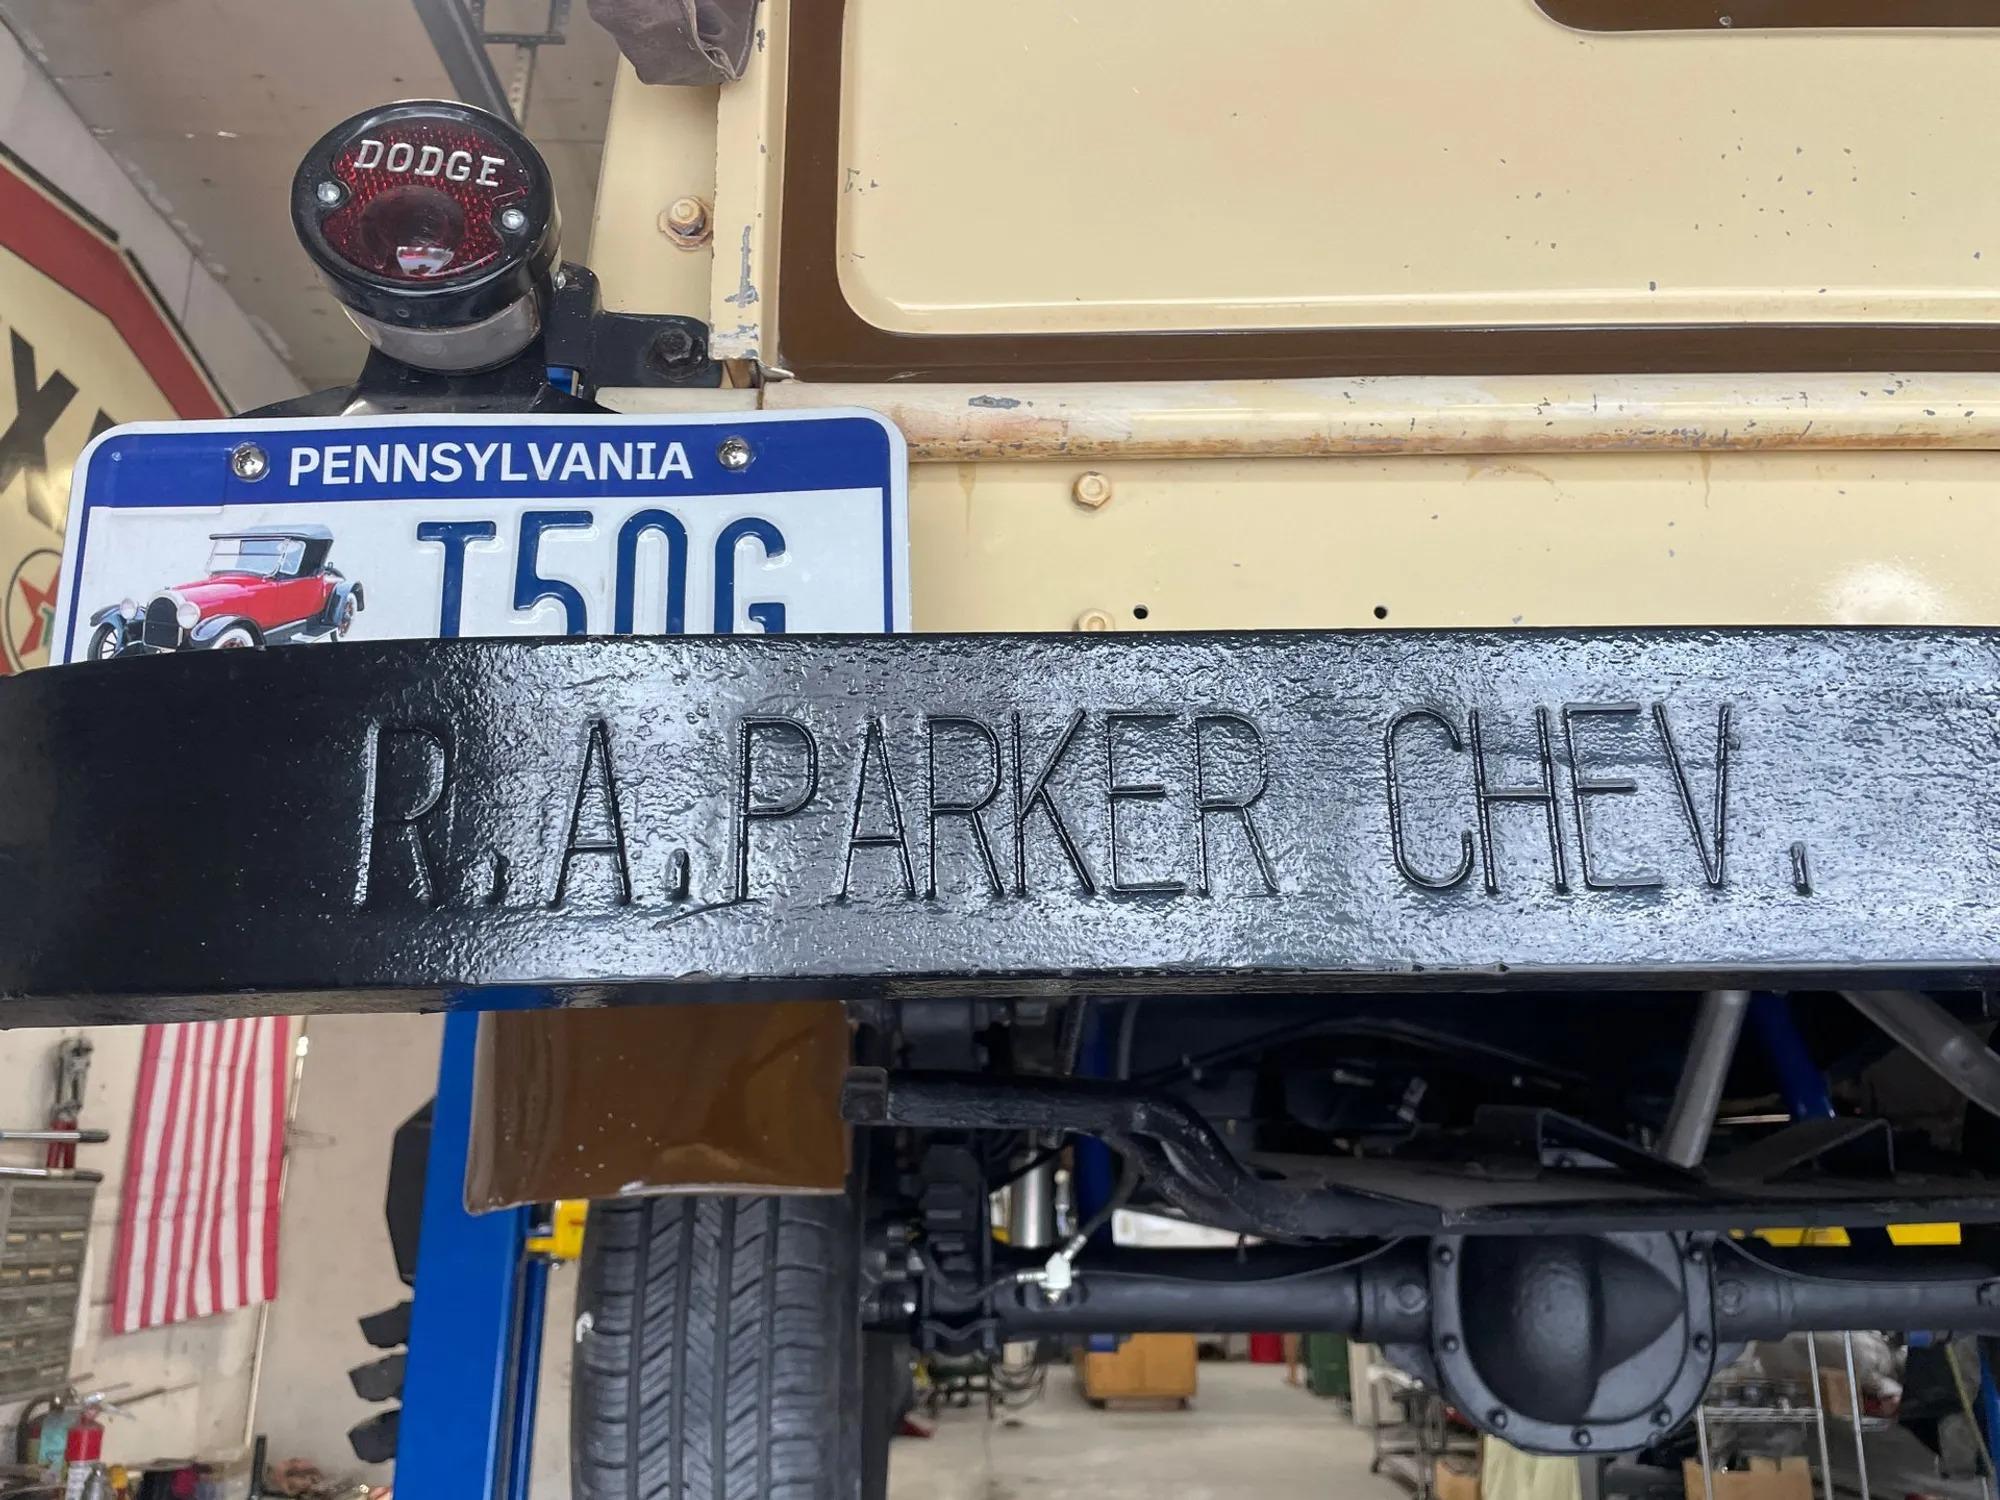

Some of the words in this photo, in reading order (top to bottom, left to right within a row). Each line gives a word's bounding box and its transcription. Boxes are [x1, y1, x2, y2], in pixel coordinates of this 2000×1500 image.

[353, 139, 505, 187] DODGE
[288, 441, 694, 488] PENNSYLVANIA
[735, 708, 1281, 905] PARKER
[1385, 702, 1812, 895] CHEV.
